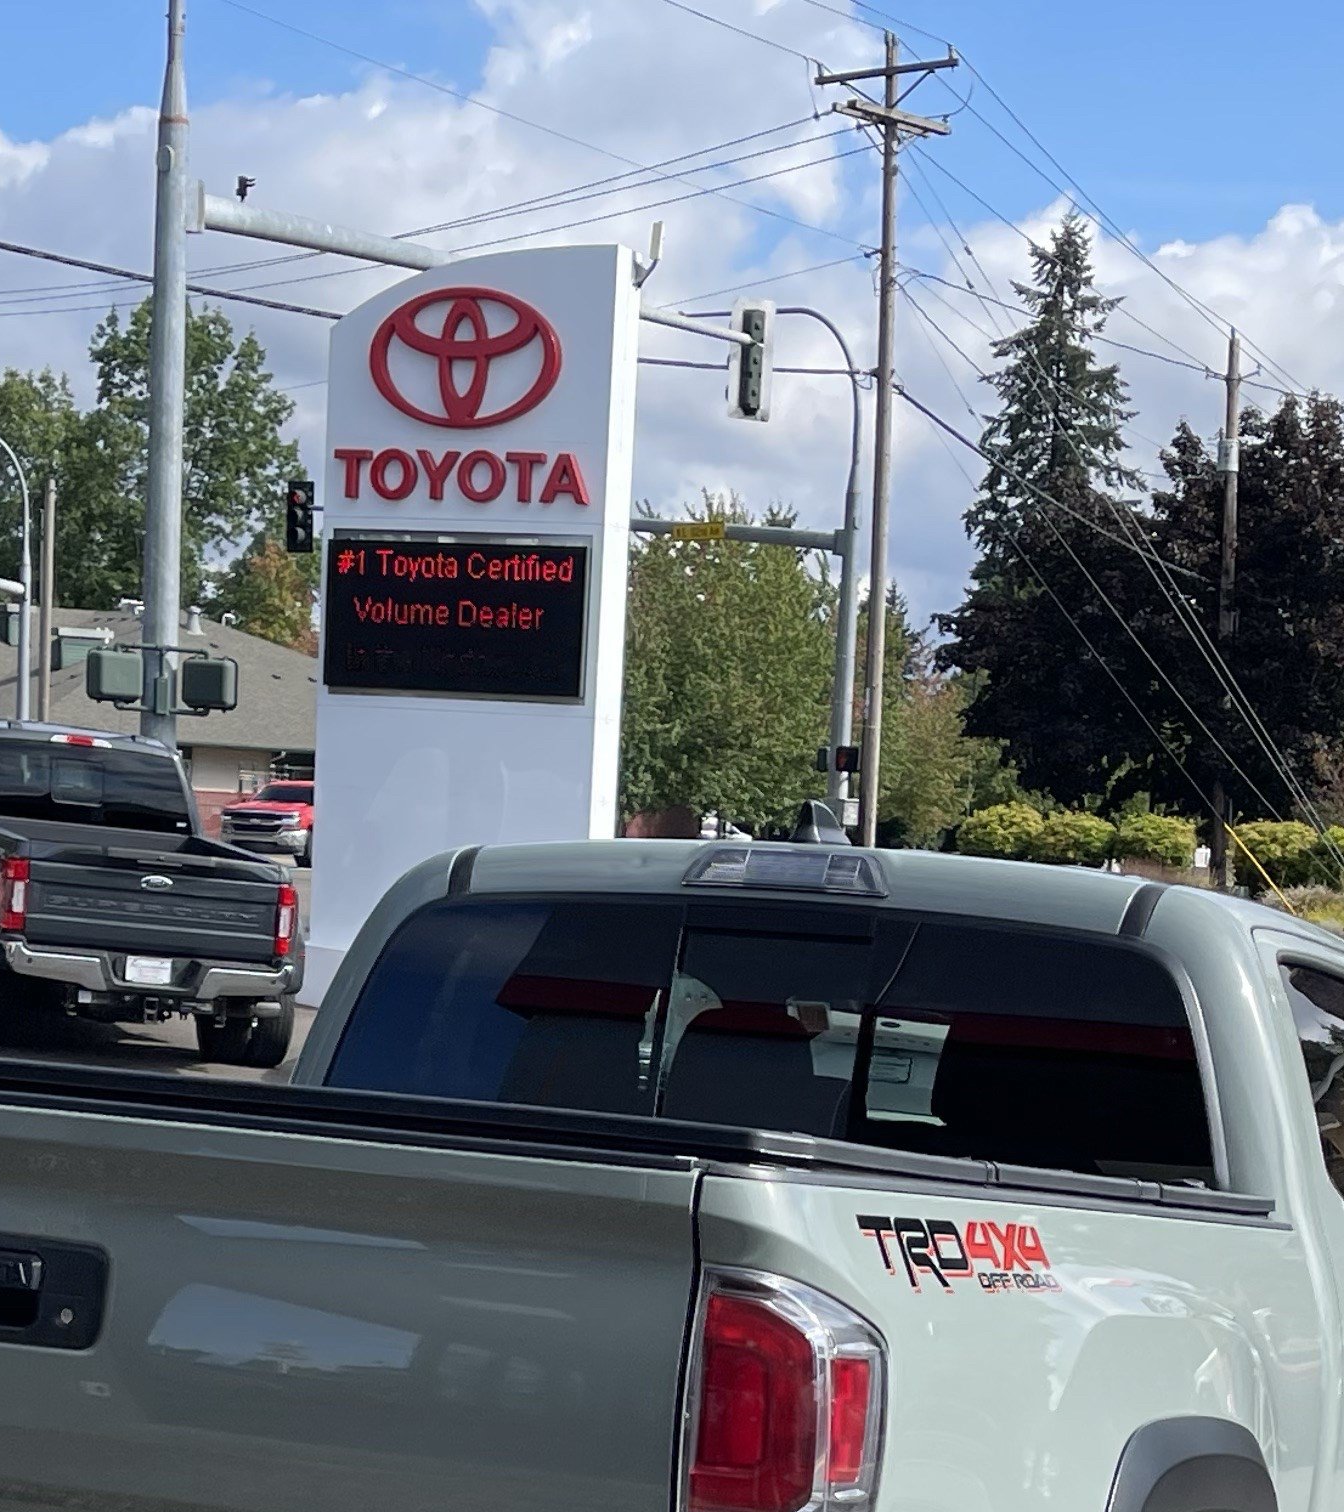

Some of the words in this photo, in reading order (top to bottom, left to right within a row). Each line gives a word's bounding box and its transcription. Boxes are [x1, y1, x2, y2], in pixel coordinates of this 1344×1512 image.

[334, 448, 590, 506] TOYOTA
[337, 549, 367, 576] #1
[376, 549, 458, 583] Toyota
[467, 552, 573, 583] Certified
[353, 596, 450, 627] Volume
[459, 599, 544, 631] Dealer
[856, 1213, 973, 1294] TRD
[977, 1272, 1011, 1292] OFF
[1013, 1273, 1062, 1292] ROAD
